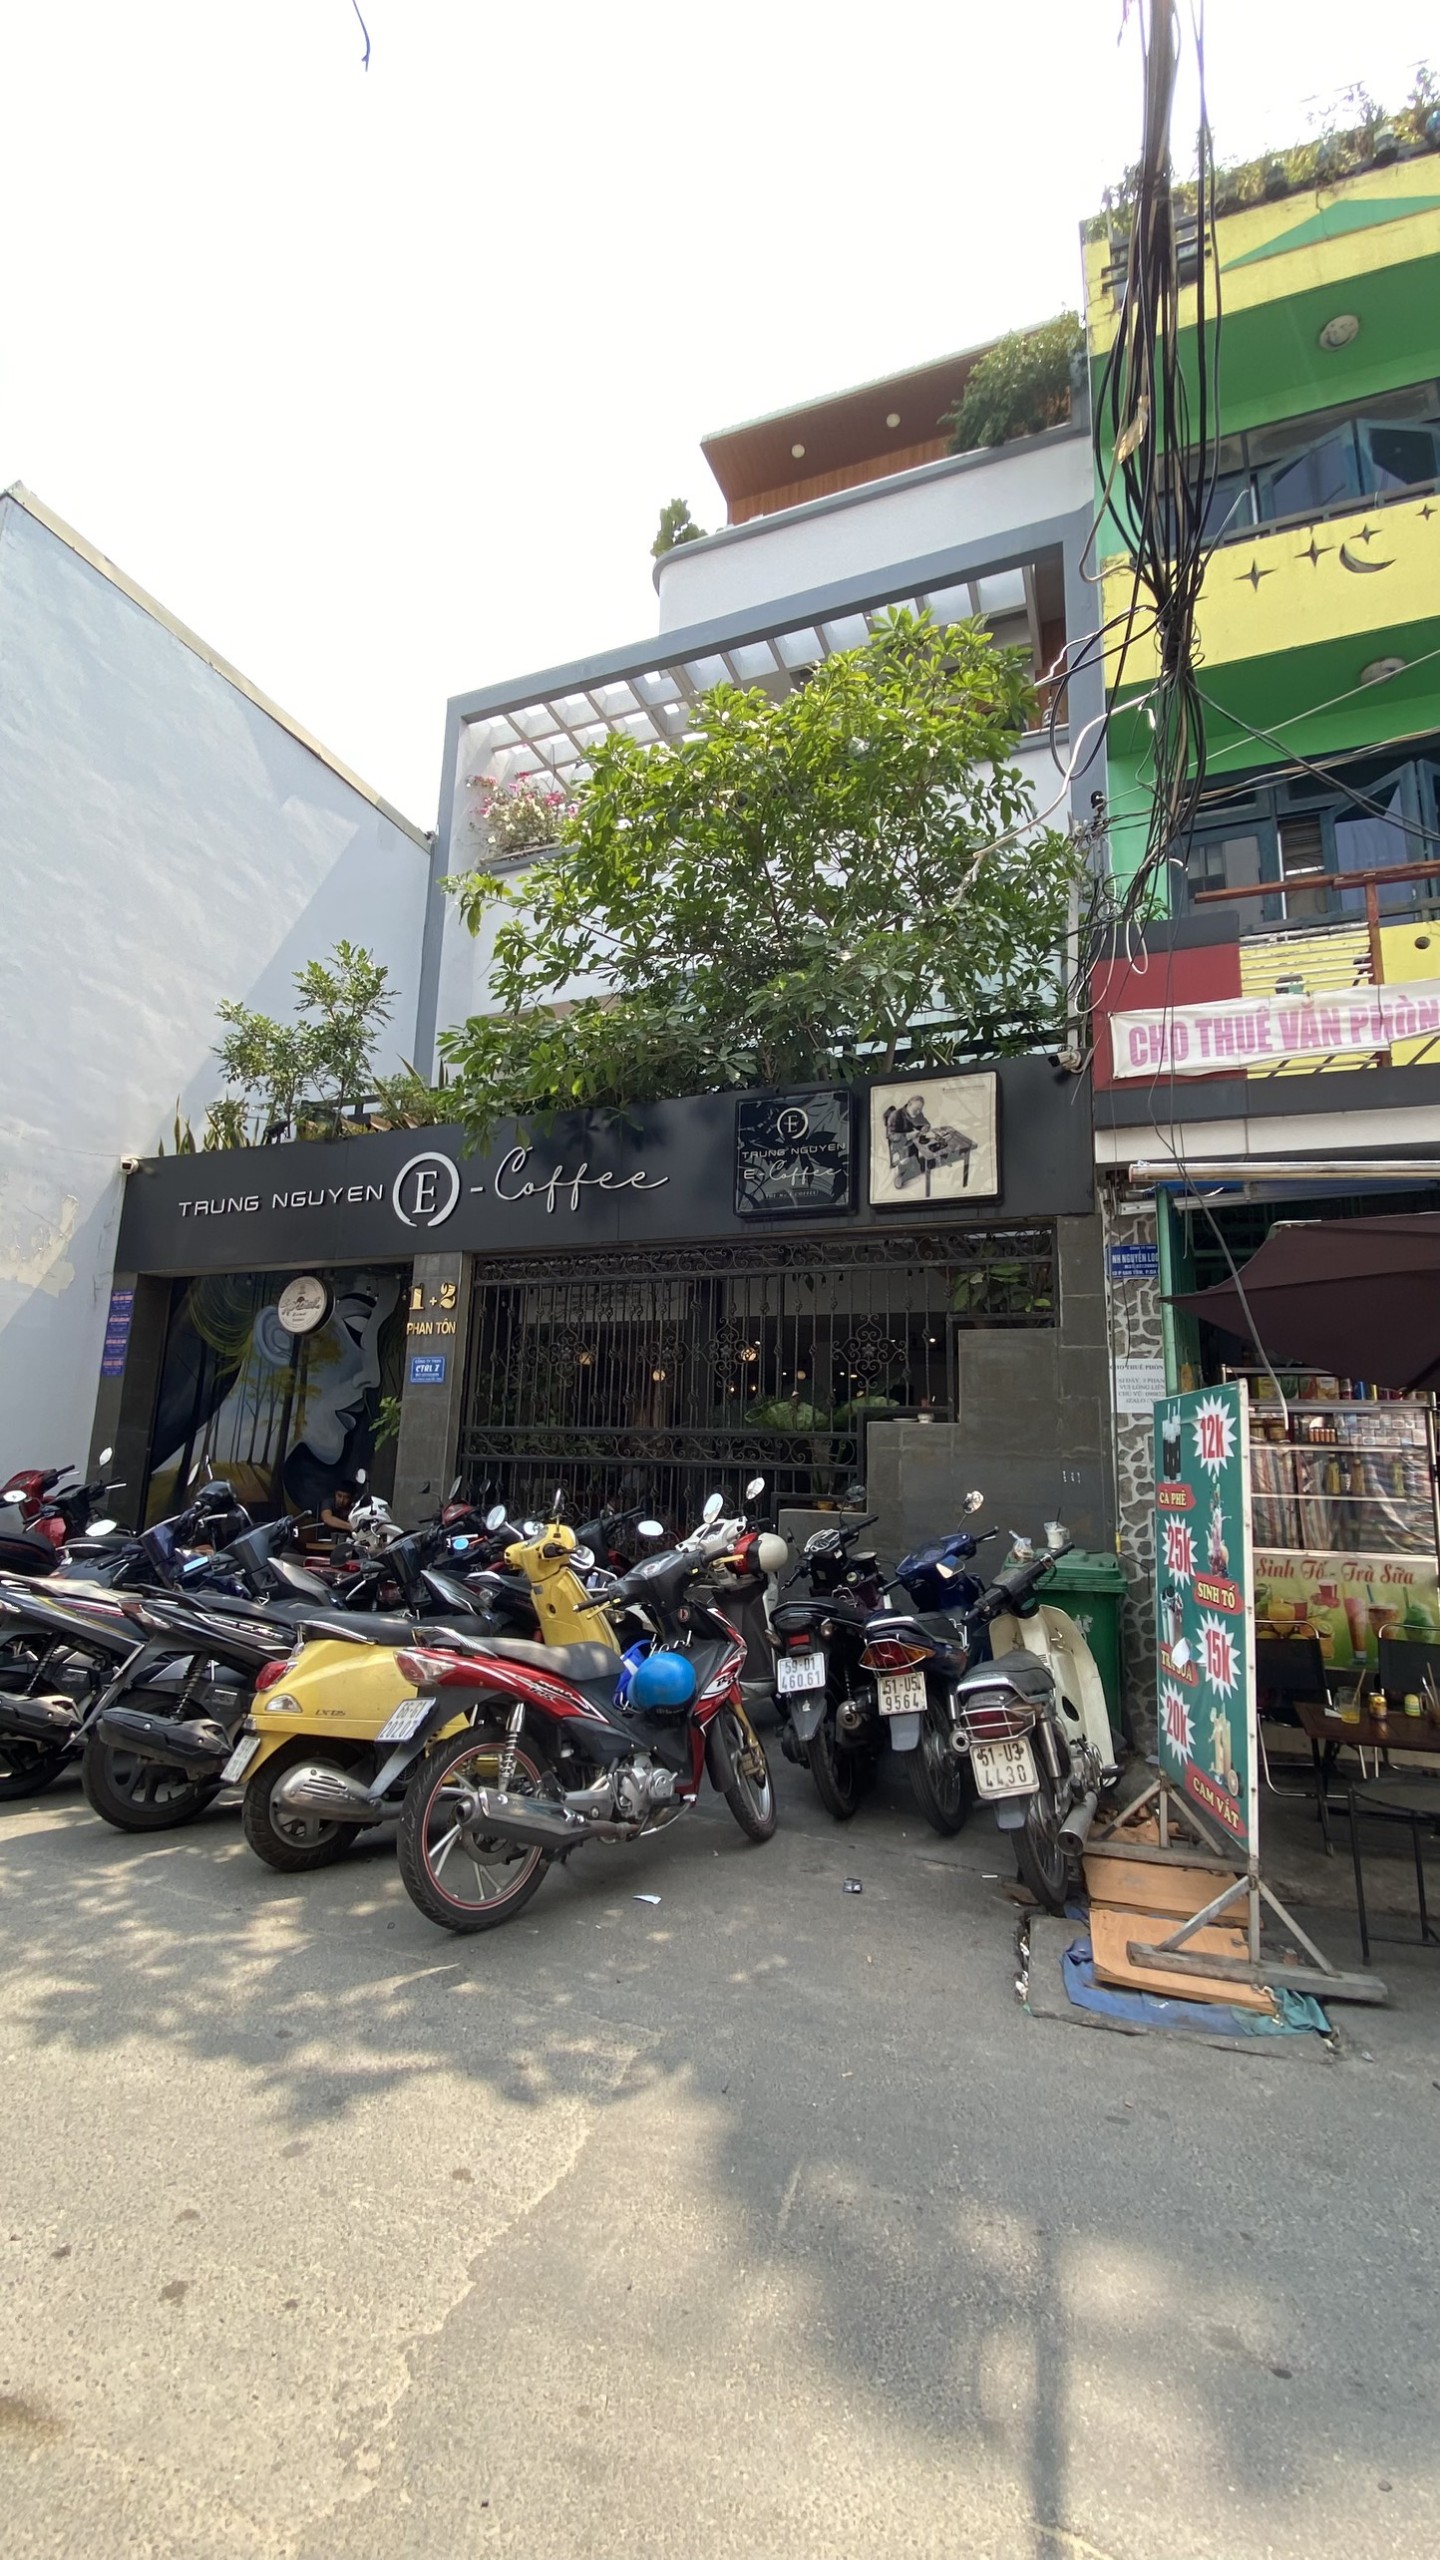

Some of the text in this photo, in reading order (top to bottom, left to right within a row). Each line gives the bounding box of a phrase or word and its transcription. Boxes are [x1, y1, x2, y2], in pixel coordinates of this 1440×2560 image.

[1128, 1020, 1189, 1068] CHO
[1195, 1005, 1274, 1058] THUÊ
[1276, 999, 1343, 1051] VĂN
[741, 1143, 846, 1159] TRUNG NGUYEN
[178, 1195, 260, 1217] TRUNG
[272, 1184, 384, 1209] NGUYEN
[494, 1145, 669, 1214] Coffee
[406, 1317, 456, 1335] PHAN TÔN
[415, 1363, 433, 1373] CTRL
[1200, 1414, 1225, 1459] 12k
[1159, 1489, 1188, 1506] CÀ PHÊ
[1167, 1526, 1192, 1573] 25k
[1255, 1557, 1295, 1579] Sinh
[1340, 1561, 1375, 1584] Trà
[1379, 1563, 1416, 1585] Sữa
[1197, 1581, 1237, 1609] SINH TỐ
[784, 1656, 815, 1675] 59-D1
[1205, 1628, 1231, 1684] 15k
[781, 1670, 822, 1691] 460.61
[884, 1677, 919, 1696] 51-U5
[885, 1696, 920, 1712] 9564
[1166, 1695, 1188, 1747] 20k
[1192, 1775, 1240, 1830] CAM VẮT
